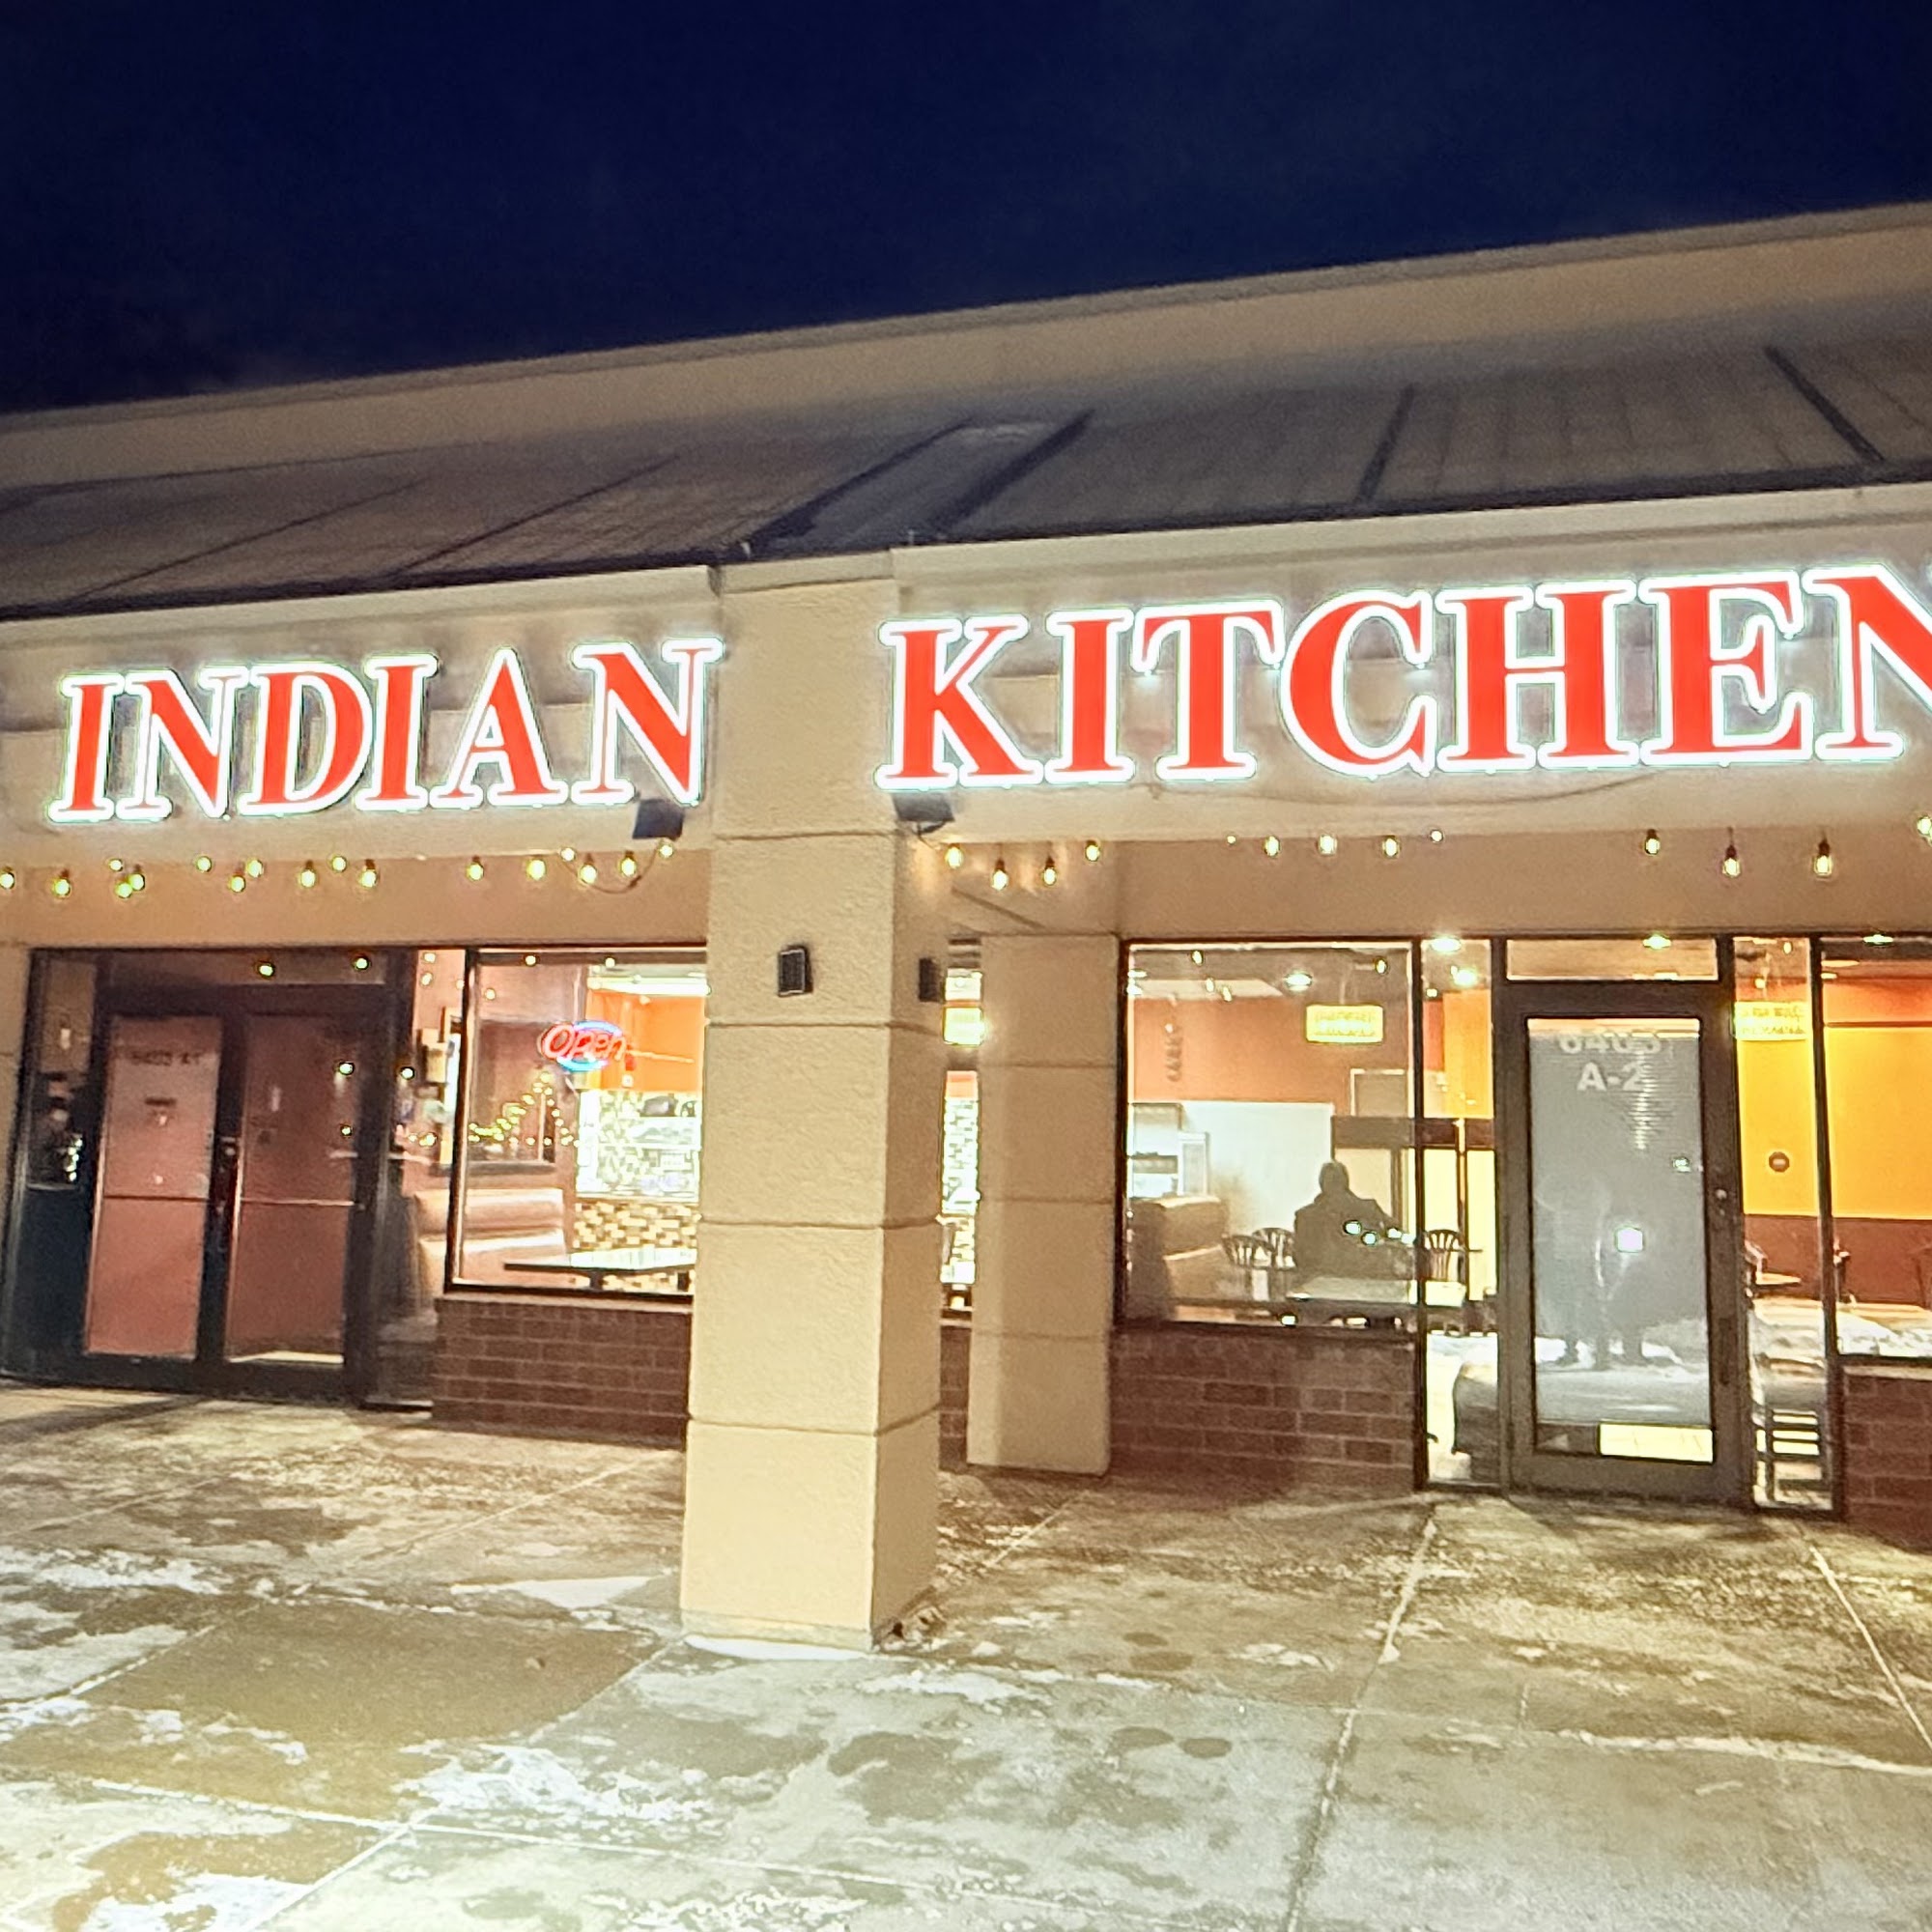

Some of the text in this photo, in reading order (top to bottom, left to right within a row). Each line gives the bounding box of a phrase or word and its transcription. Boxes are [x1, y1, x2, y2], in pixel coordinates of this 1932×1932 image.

[48, 563, 1932, 823] INDIAN KITCHEN
[1577, 1061, 1645, 1092] A-2
